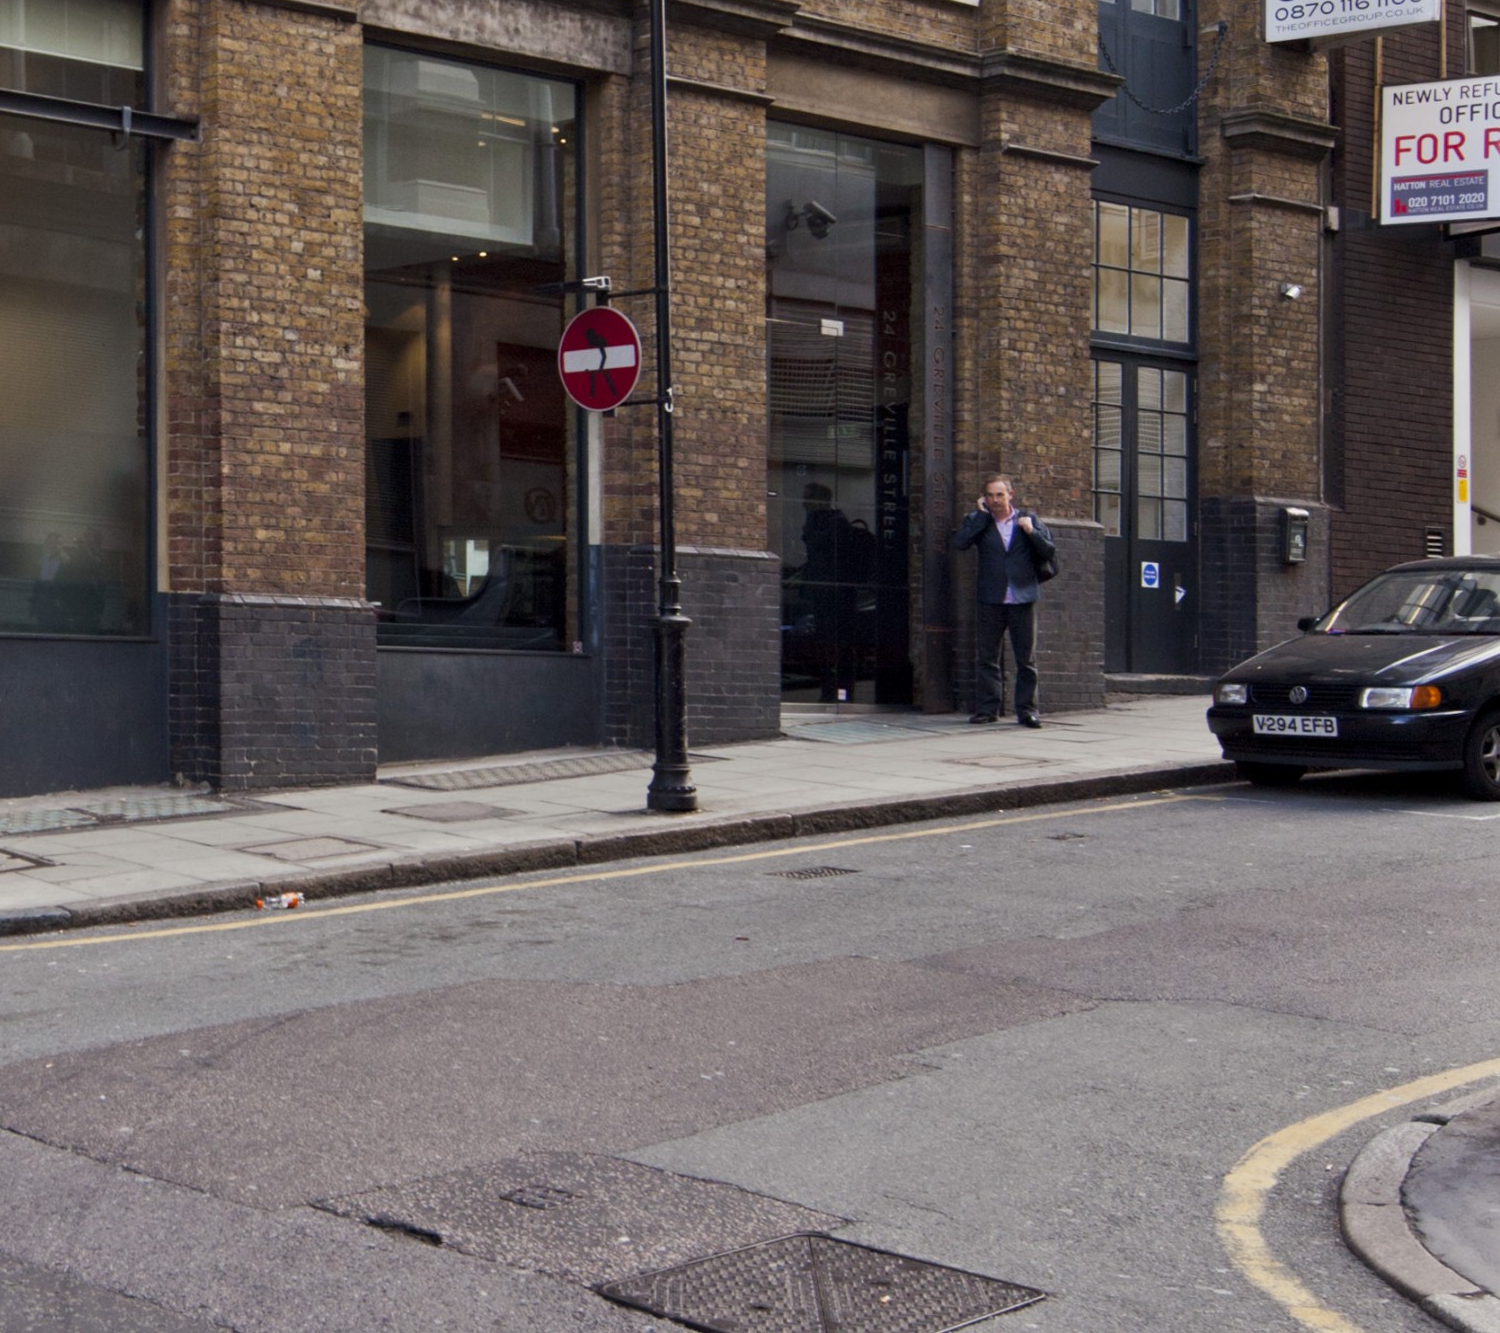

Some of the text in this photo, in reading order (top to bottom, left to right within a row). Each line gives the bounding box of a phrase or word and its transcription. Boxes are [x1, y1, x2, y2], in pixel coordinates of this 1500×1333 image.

[1275, 0, 1334, 21] 0870
[1275, 6, 1425, 34] THEOFFICEGROUP.CO.UK
[1393, 86, 1452, 106] NEWLY
[1440, 101, 1500, 124] OFFIC
[1395, 131, 1466, 167] FOR
[1393, 176, 1485, 191] HATTON REAL ESTATE
[1408, 192, 1485, 208] 020 7101 2020
[883, 311, 896, 335] 24
[933, 304, 944, 331] 24
[883, 351, 897, 461] GREVILLE
[933, 347, 944, 458] GREVILLE
[1255, 717, 1335, 733] V294 EFB
